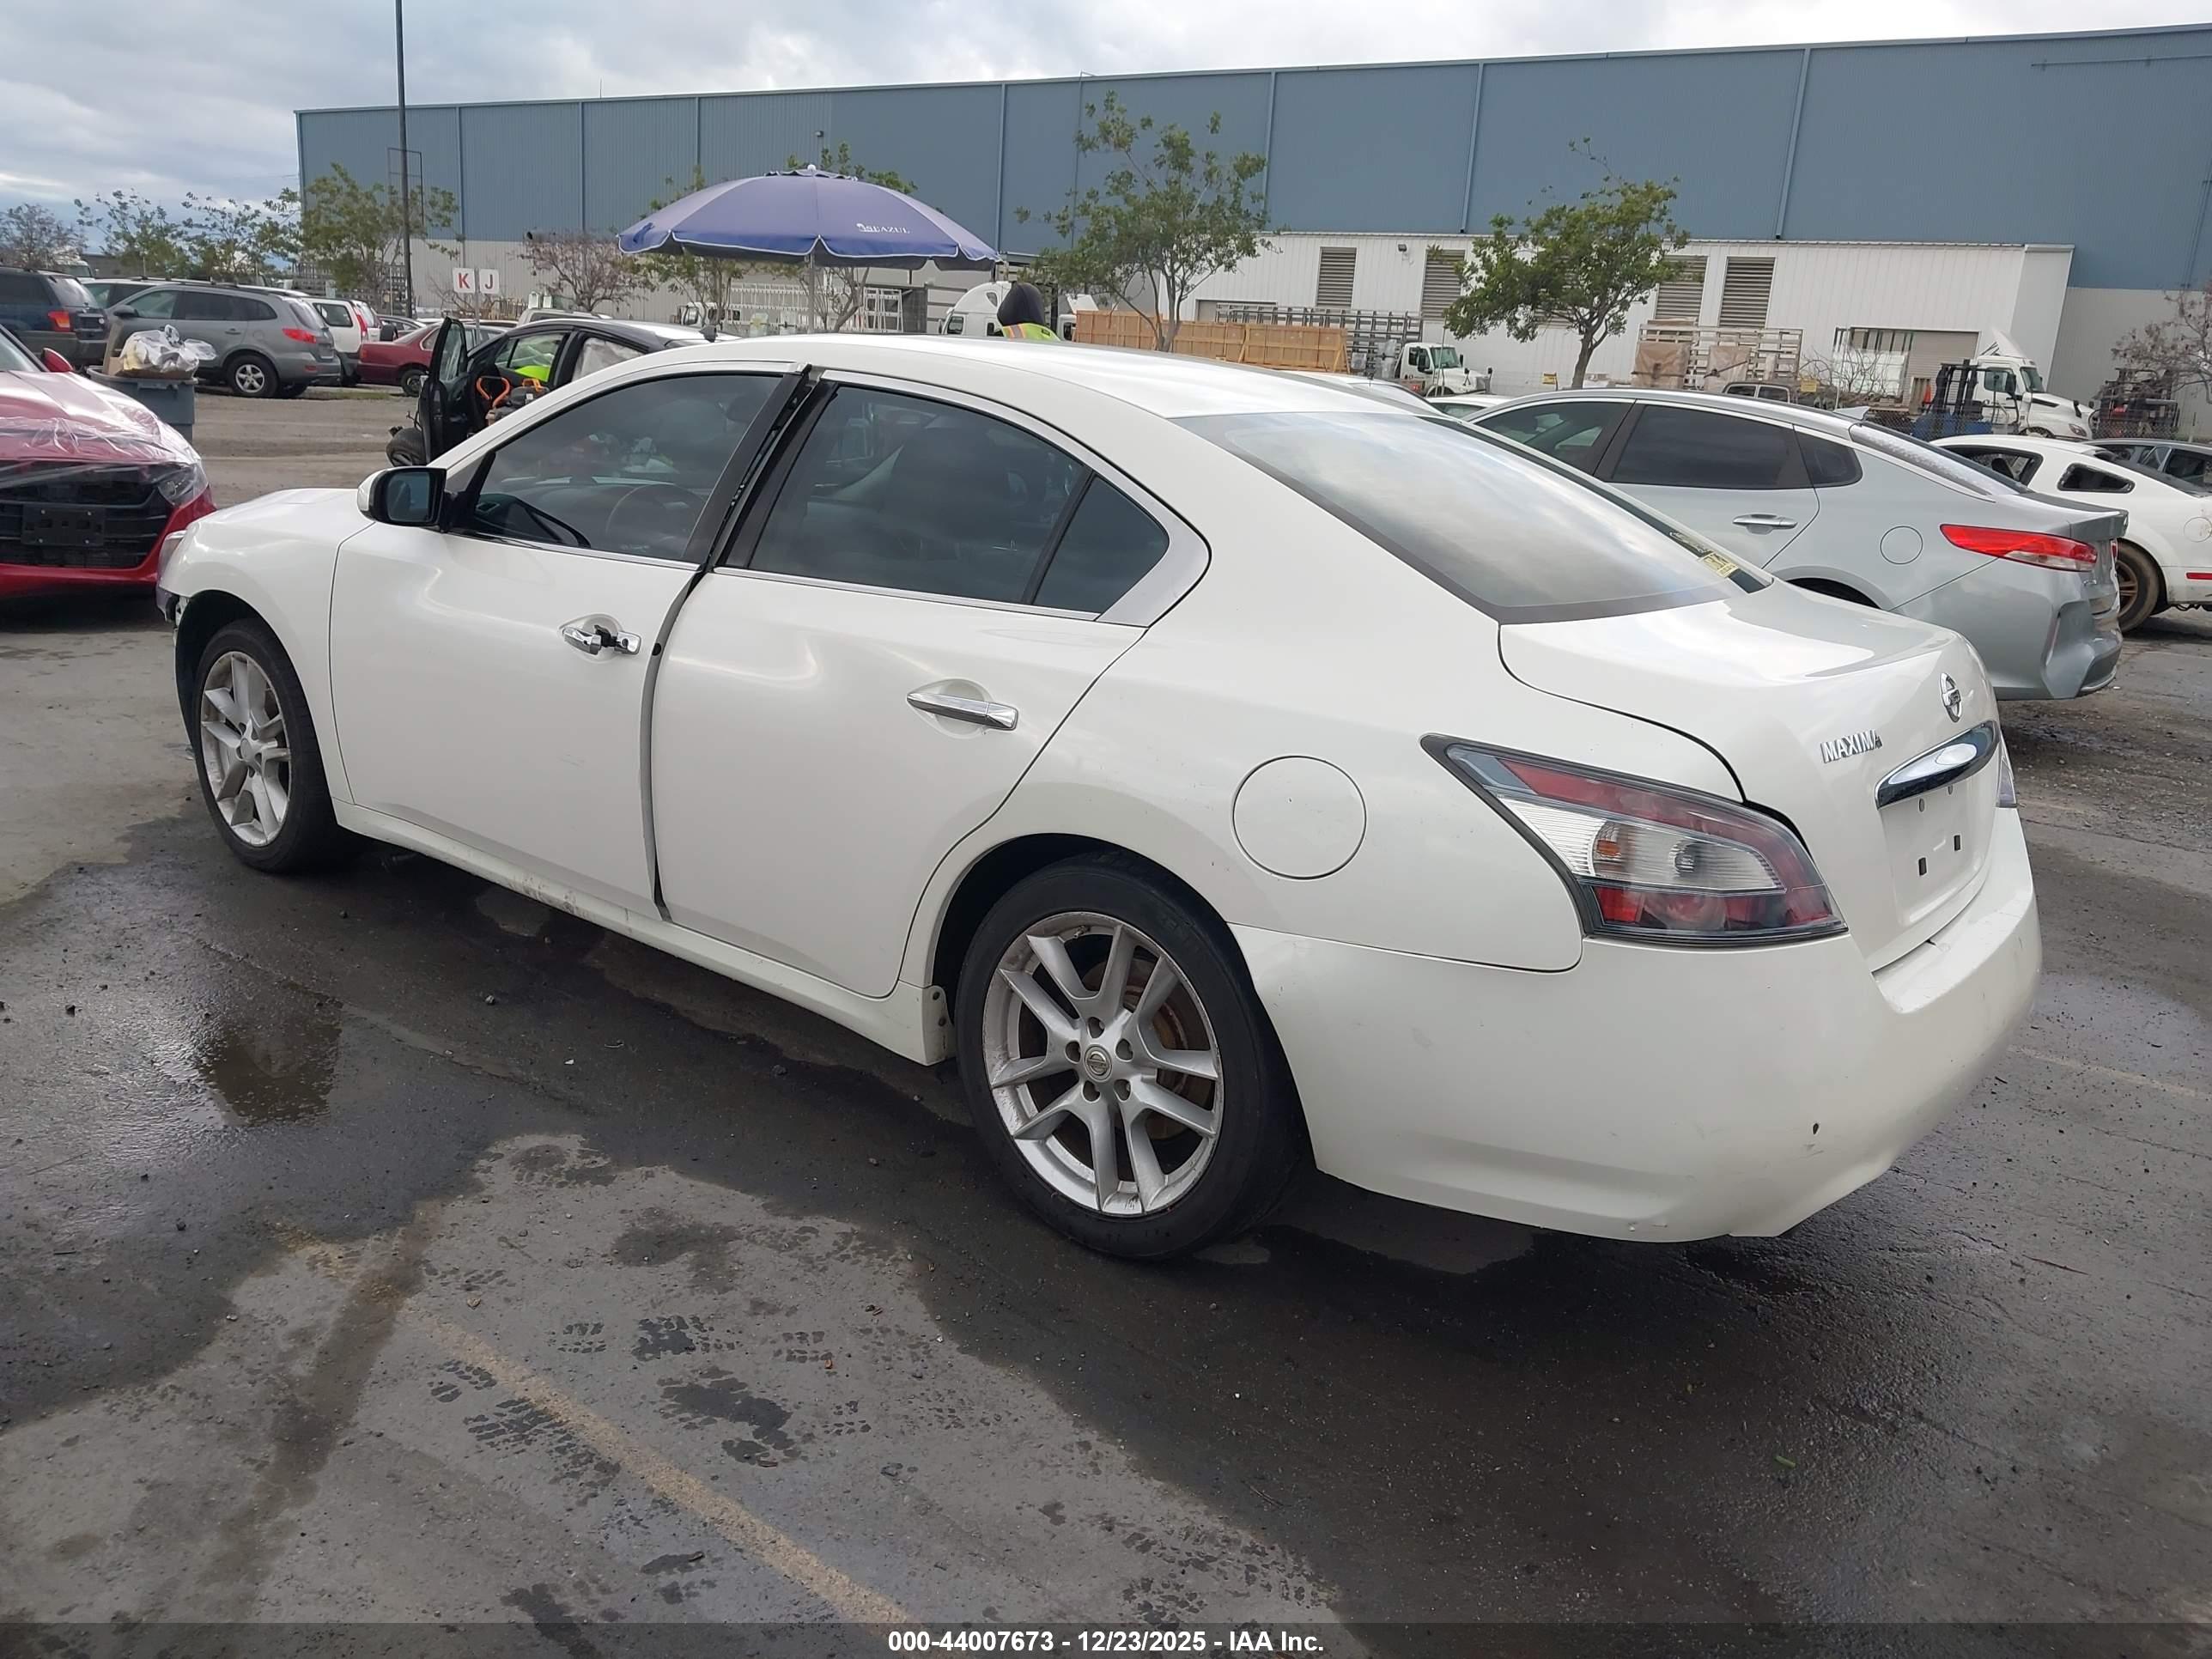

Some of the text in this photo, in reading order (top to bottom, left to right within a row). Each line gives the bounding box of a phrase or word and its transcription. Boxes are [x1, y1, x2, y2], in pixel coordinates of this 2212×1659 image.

[458, 272, 471, 289] K
[484, 274, 494, 289] J
[1820, 729, 1883, 764] MAXIMA
